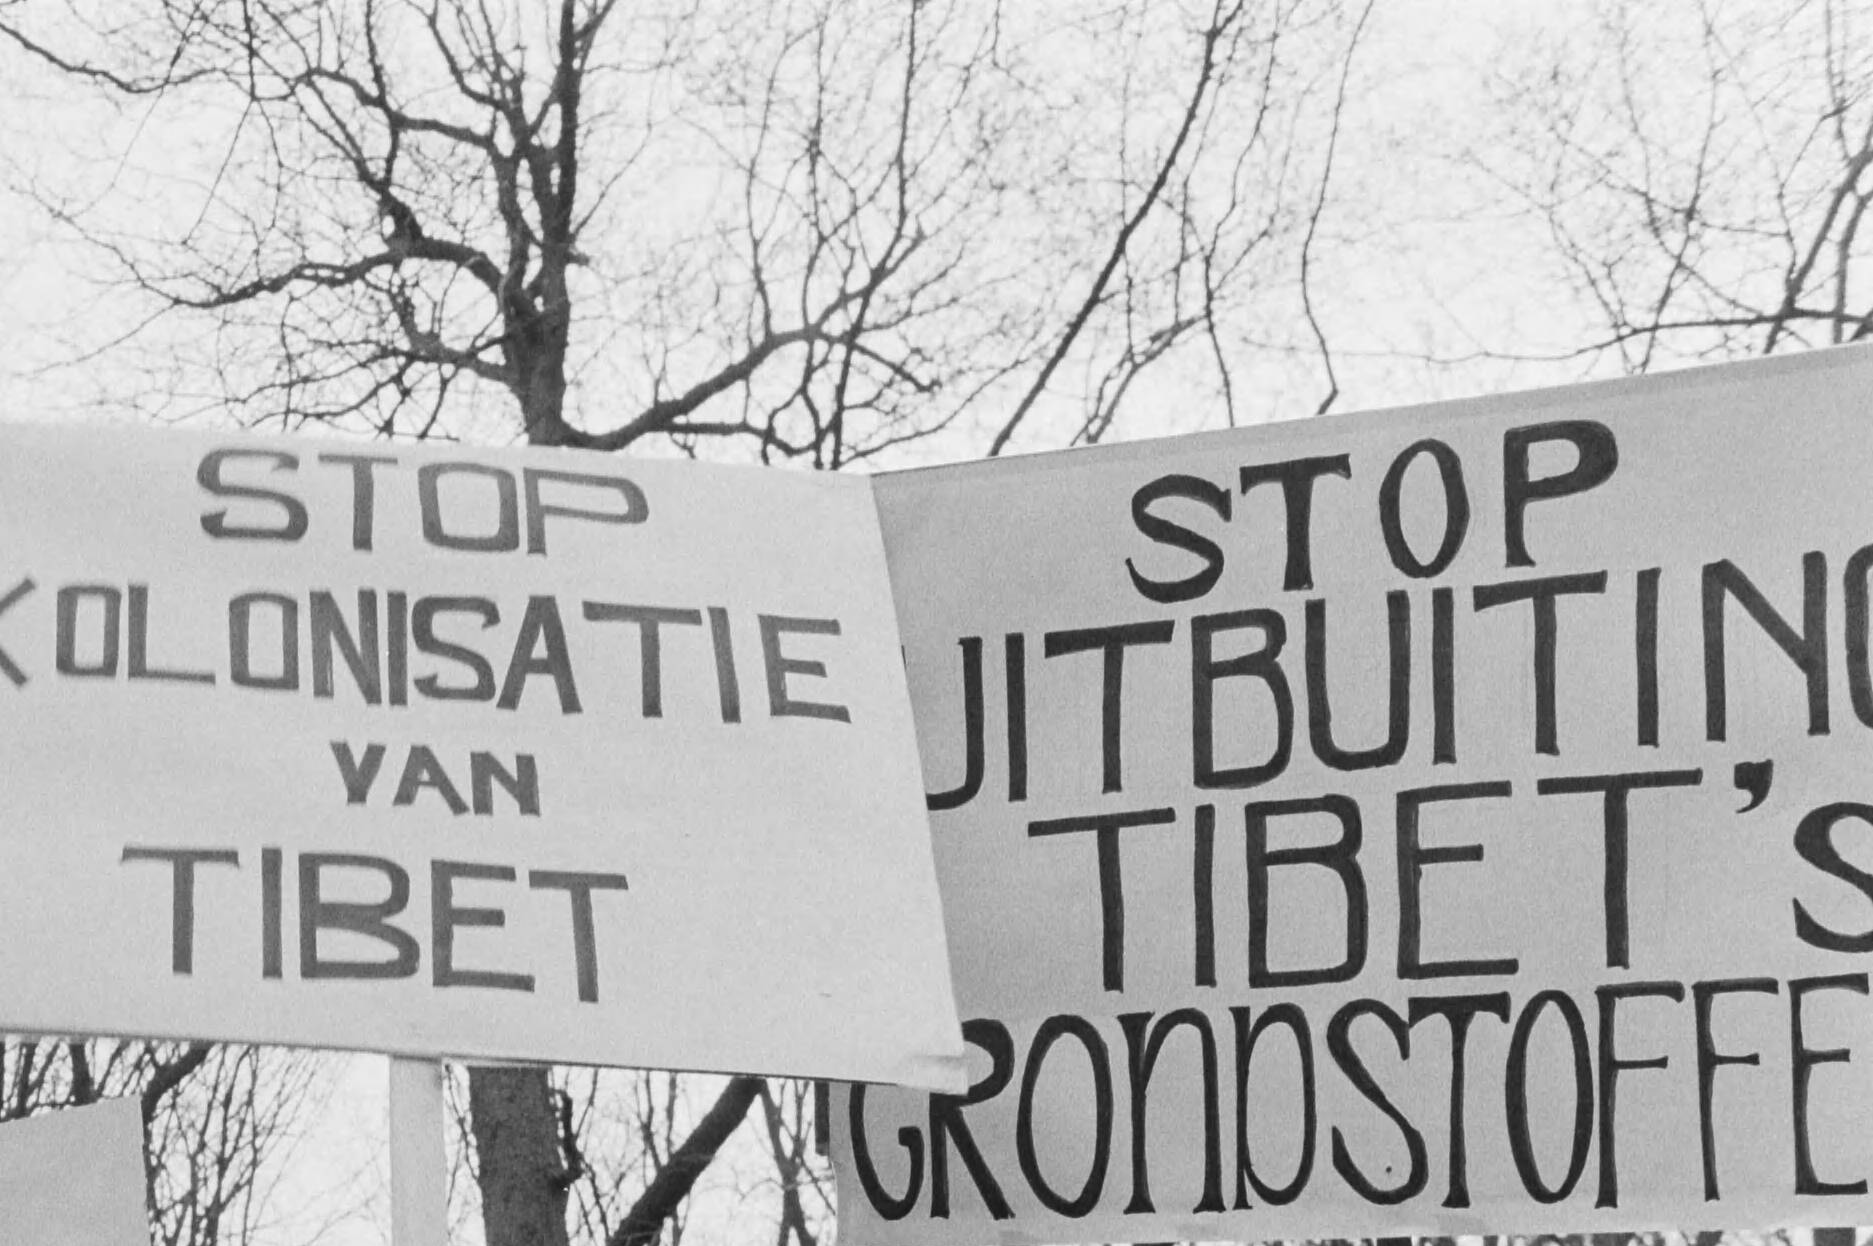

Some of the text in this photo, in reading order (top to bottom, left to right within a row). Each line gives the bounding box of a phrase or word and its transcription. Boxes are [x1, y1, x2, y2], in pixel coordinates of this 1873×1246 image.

[195, 446, 650, 556] STOP
[1125, 419, 1619, 604] STOP
[328, 740, 541, 818] VAN
[121, 845, 629, 1003] TIBET
[1027, 758, 1873, 994] TIBET'S
